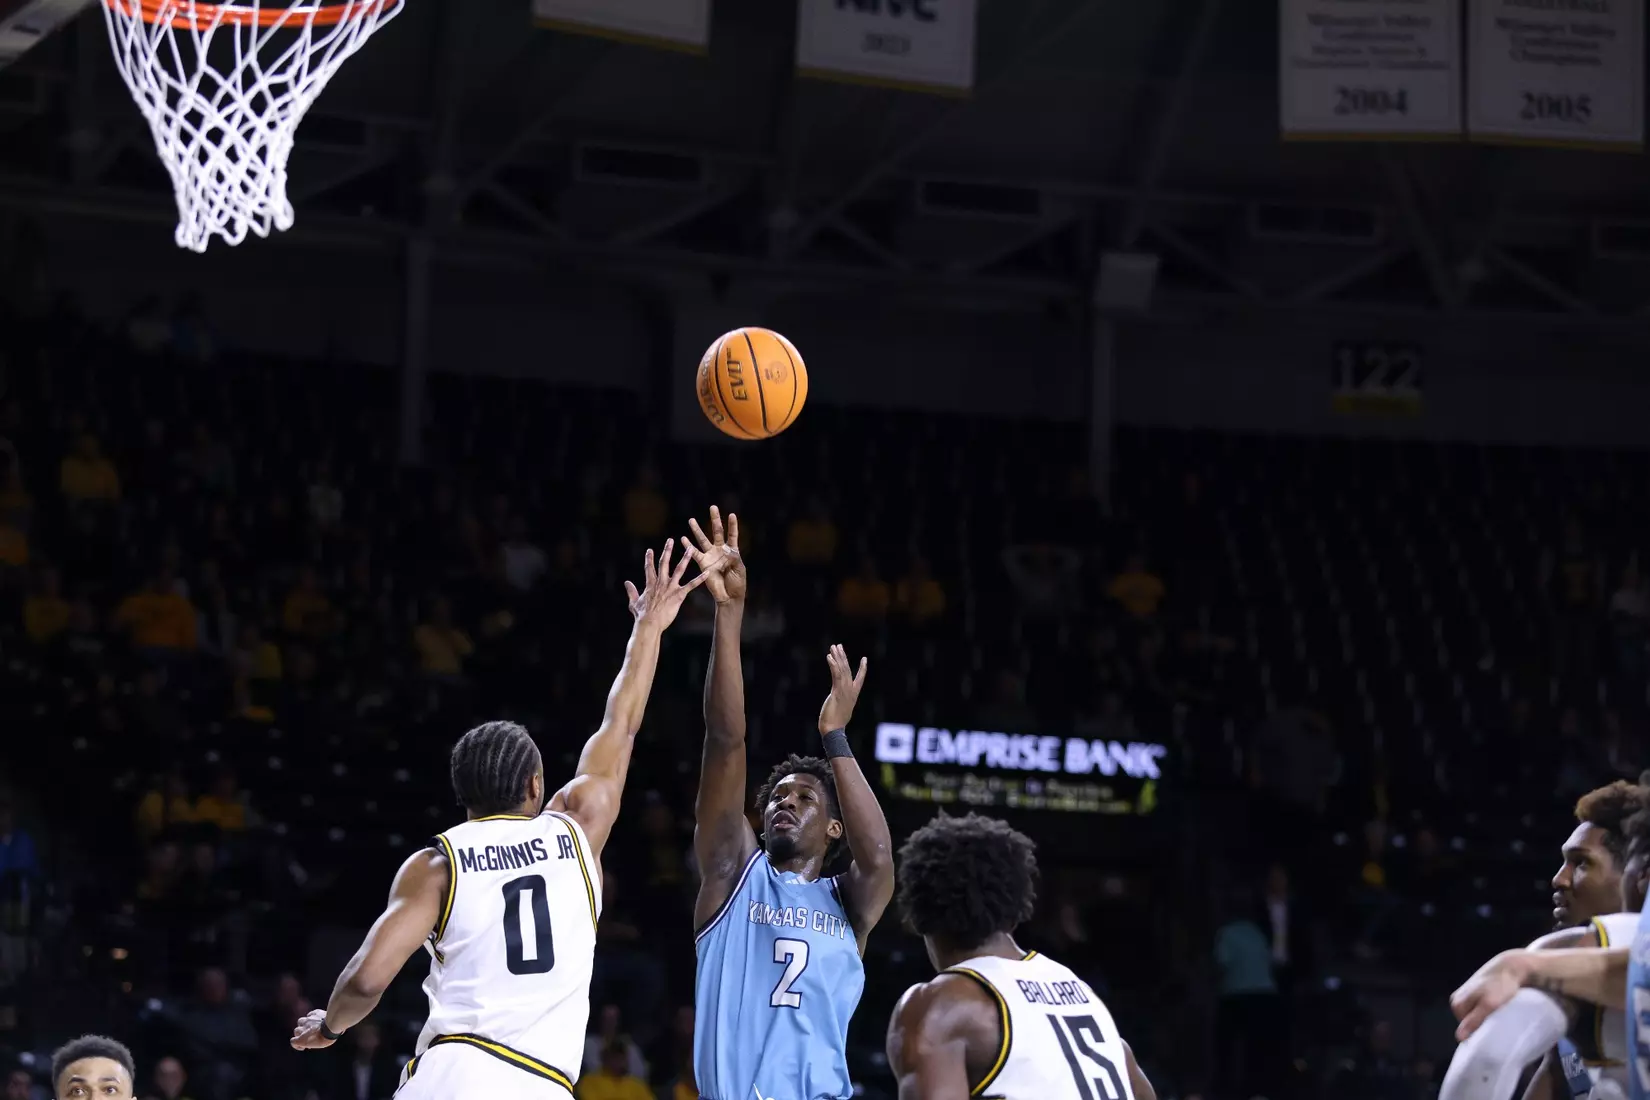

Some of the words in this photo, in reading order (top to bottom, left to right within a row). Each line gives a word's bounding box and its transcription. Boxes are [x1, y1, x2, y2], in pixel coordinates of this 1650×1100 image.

[1335, 85, 1408, 115] 2004
[1521, 92, 1592, 124] 2005
[1339, 347, 1421, 395] 122
[917, 727, 1060, 772] EMPRISE
[1064, 737, 1164, 779] BANK
[458, 838, 548, 873] McGINNIS
[557, 834, 575, 859] JR
[502, 874, 555, 975] 0
[749, 900, 808, 929] KANSAS
[812, 909, 847, 940] CITY
[769, 937, 810, 1009] 2
[1016, 979, 1090, 1005] BALLARD
[1046, 1014, 1128, 1100] 15
